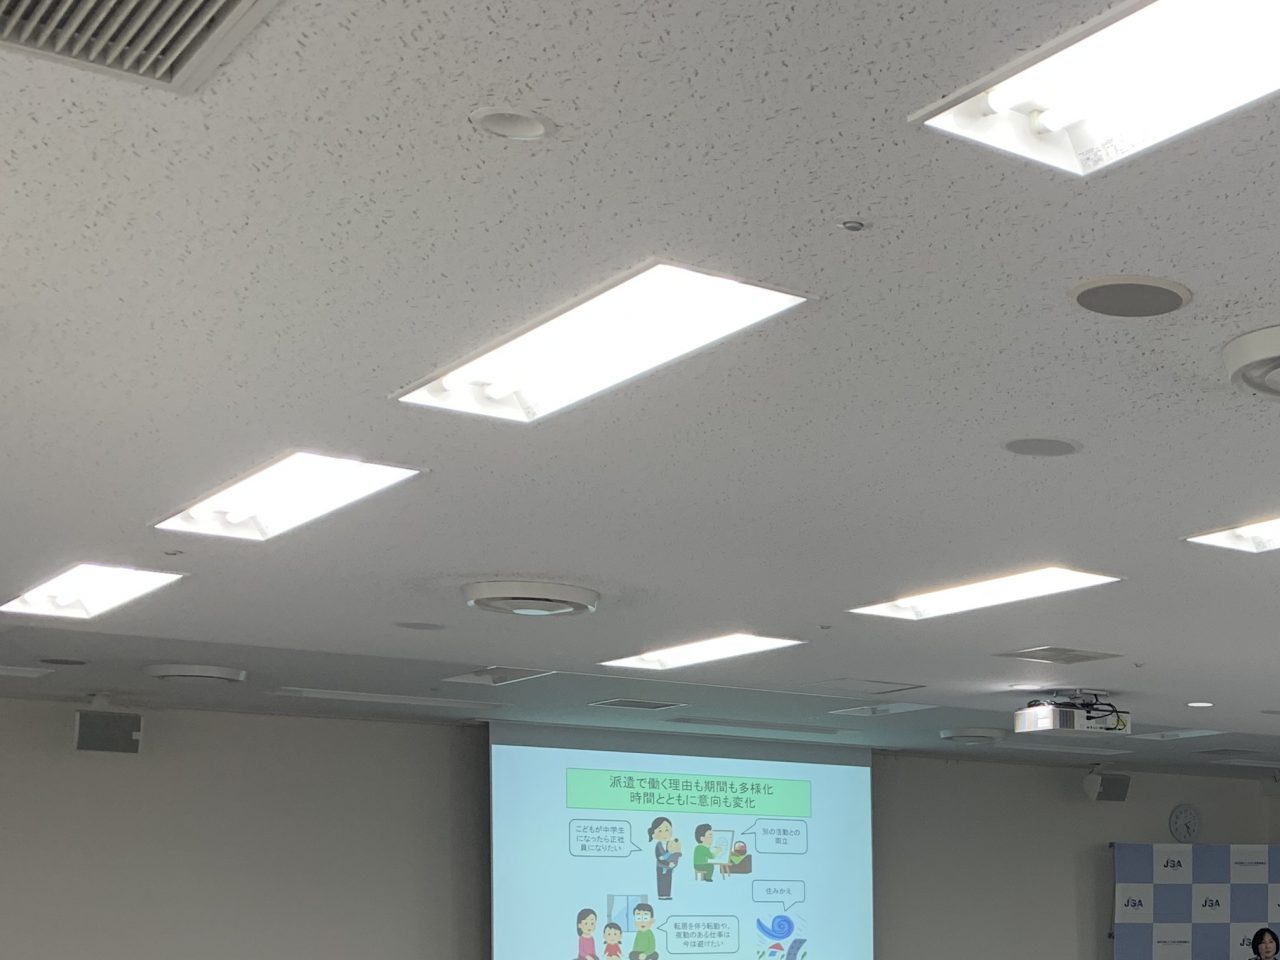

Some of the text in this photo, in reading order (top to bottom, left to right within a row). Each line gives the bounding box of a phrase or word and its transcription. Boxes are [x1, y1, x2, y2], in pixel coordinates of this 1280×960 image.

[609, 775, 774, 795] 派遣で働く理由も期間も多様化
[629, 791, 756, 809] 時間とともに意向も変化
[575, 825, 625, 835] こどもが中学生
[765, 887, 792, 895] 住みかえ
[1240, 937, 1252, 947] JS
